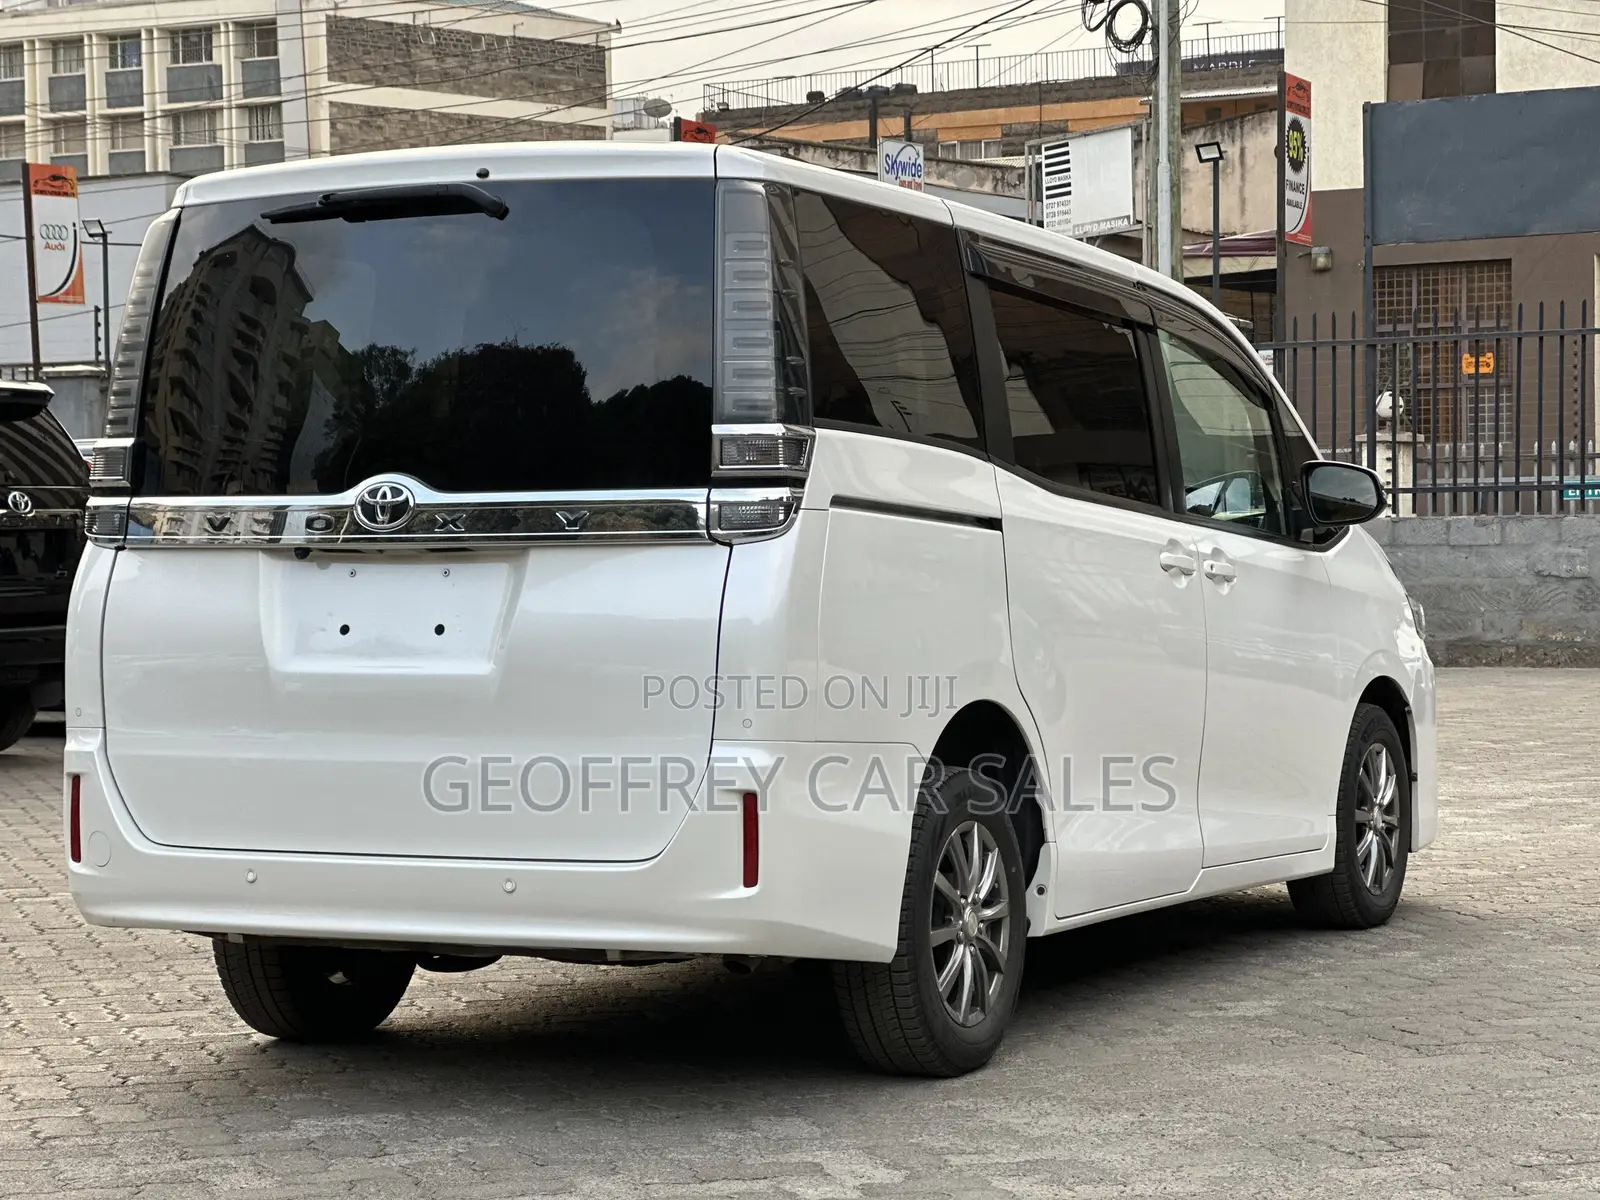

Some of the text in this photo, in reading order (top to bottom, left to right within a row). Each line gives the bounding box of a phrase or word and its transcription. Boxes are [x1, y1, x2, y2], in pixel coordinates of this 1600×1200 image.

[1288, 129, 1304, 161] 95%
[885, 153, 922, 180] Skywide
[1045, 174, 1071, 184] LLOYD MASIKA
[1286, 179, 1305, 195] FINANCE
[1075, 223, 1098, 234] LLOYD
[1099, 217, 1128, 229] MASIKA
[44, 241, 65, 251] Audi
[206, 511, 590, 532] VOXY
